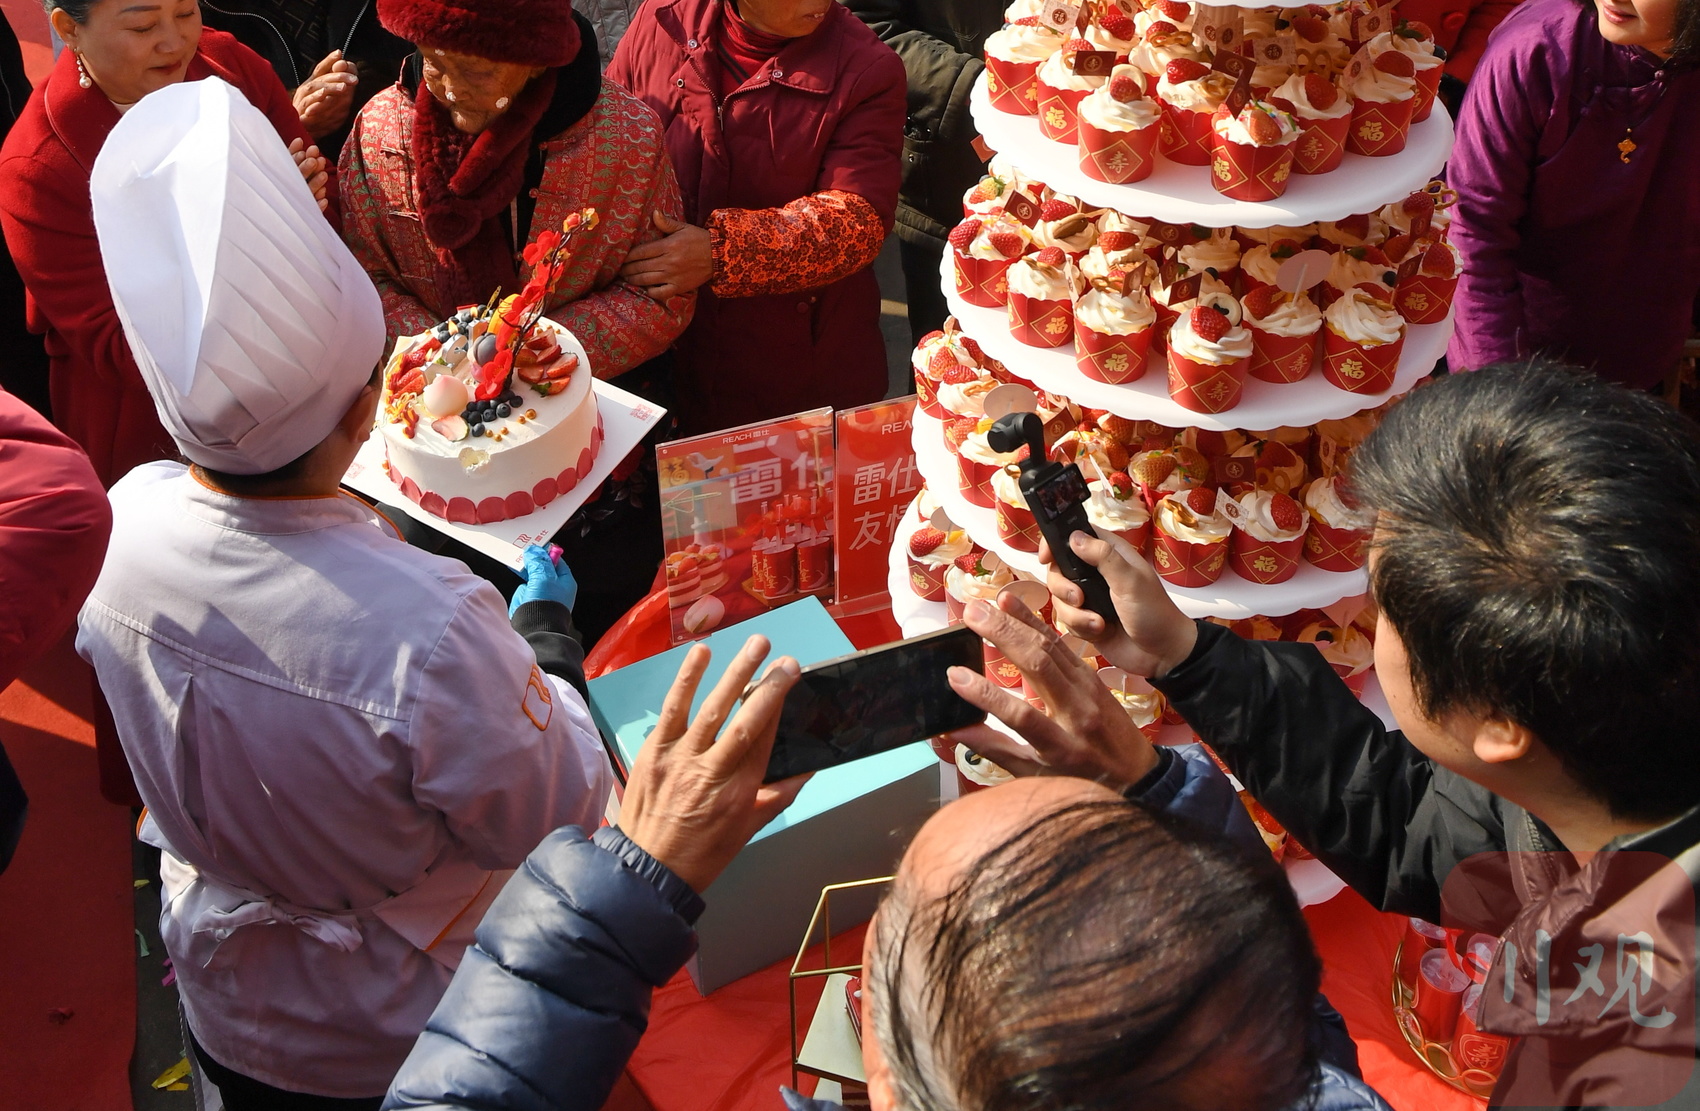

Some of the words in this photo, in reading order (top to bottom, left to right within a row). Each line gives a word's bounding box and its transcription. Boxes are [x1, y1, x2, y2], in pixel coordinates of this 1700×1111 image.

[1045, 106, 1067, 129] 福
[1358, 120, 1384, 141] 福
[1301, 138, 1324, 160] 寿
[1106, 150, 1129, 174] 寿
[1213, 156, 1232, 182] 福
[1272, 162, 1290, 183] 福
[1404, 292, 1429, 311] 福
[1045, 316, 1068, 335] 福
[1104, 353, 1129, 372] 福
[1289, 353, 1308, 373] 寿
[1340, 358, 1366, 380] 福
[1207, 380, 1229, 401] 寿
[723, 432, 752, 444] REACH
[1154, 545, 1170, 568] 福
[1253, 555, 1278, 572] 福
